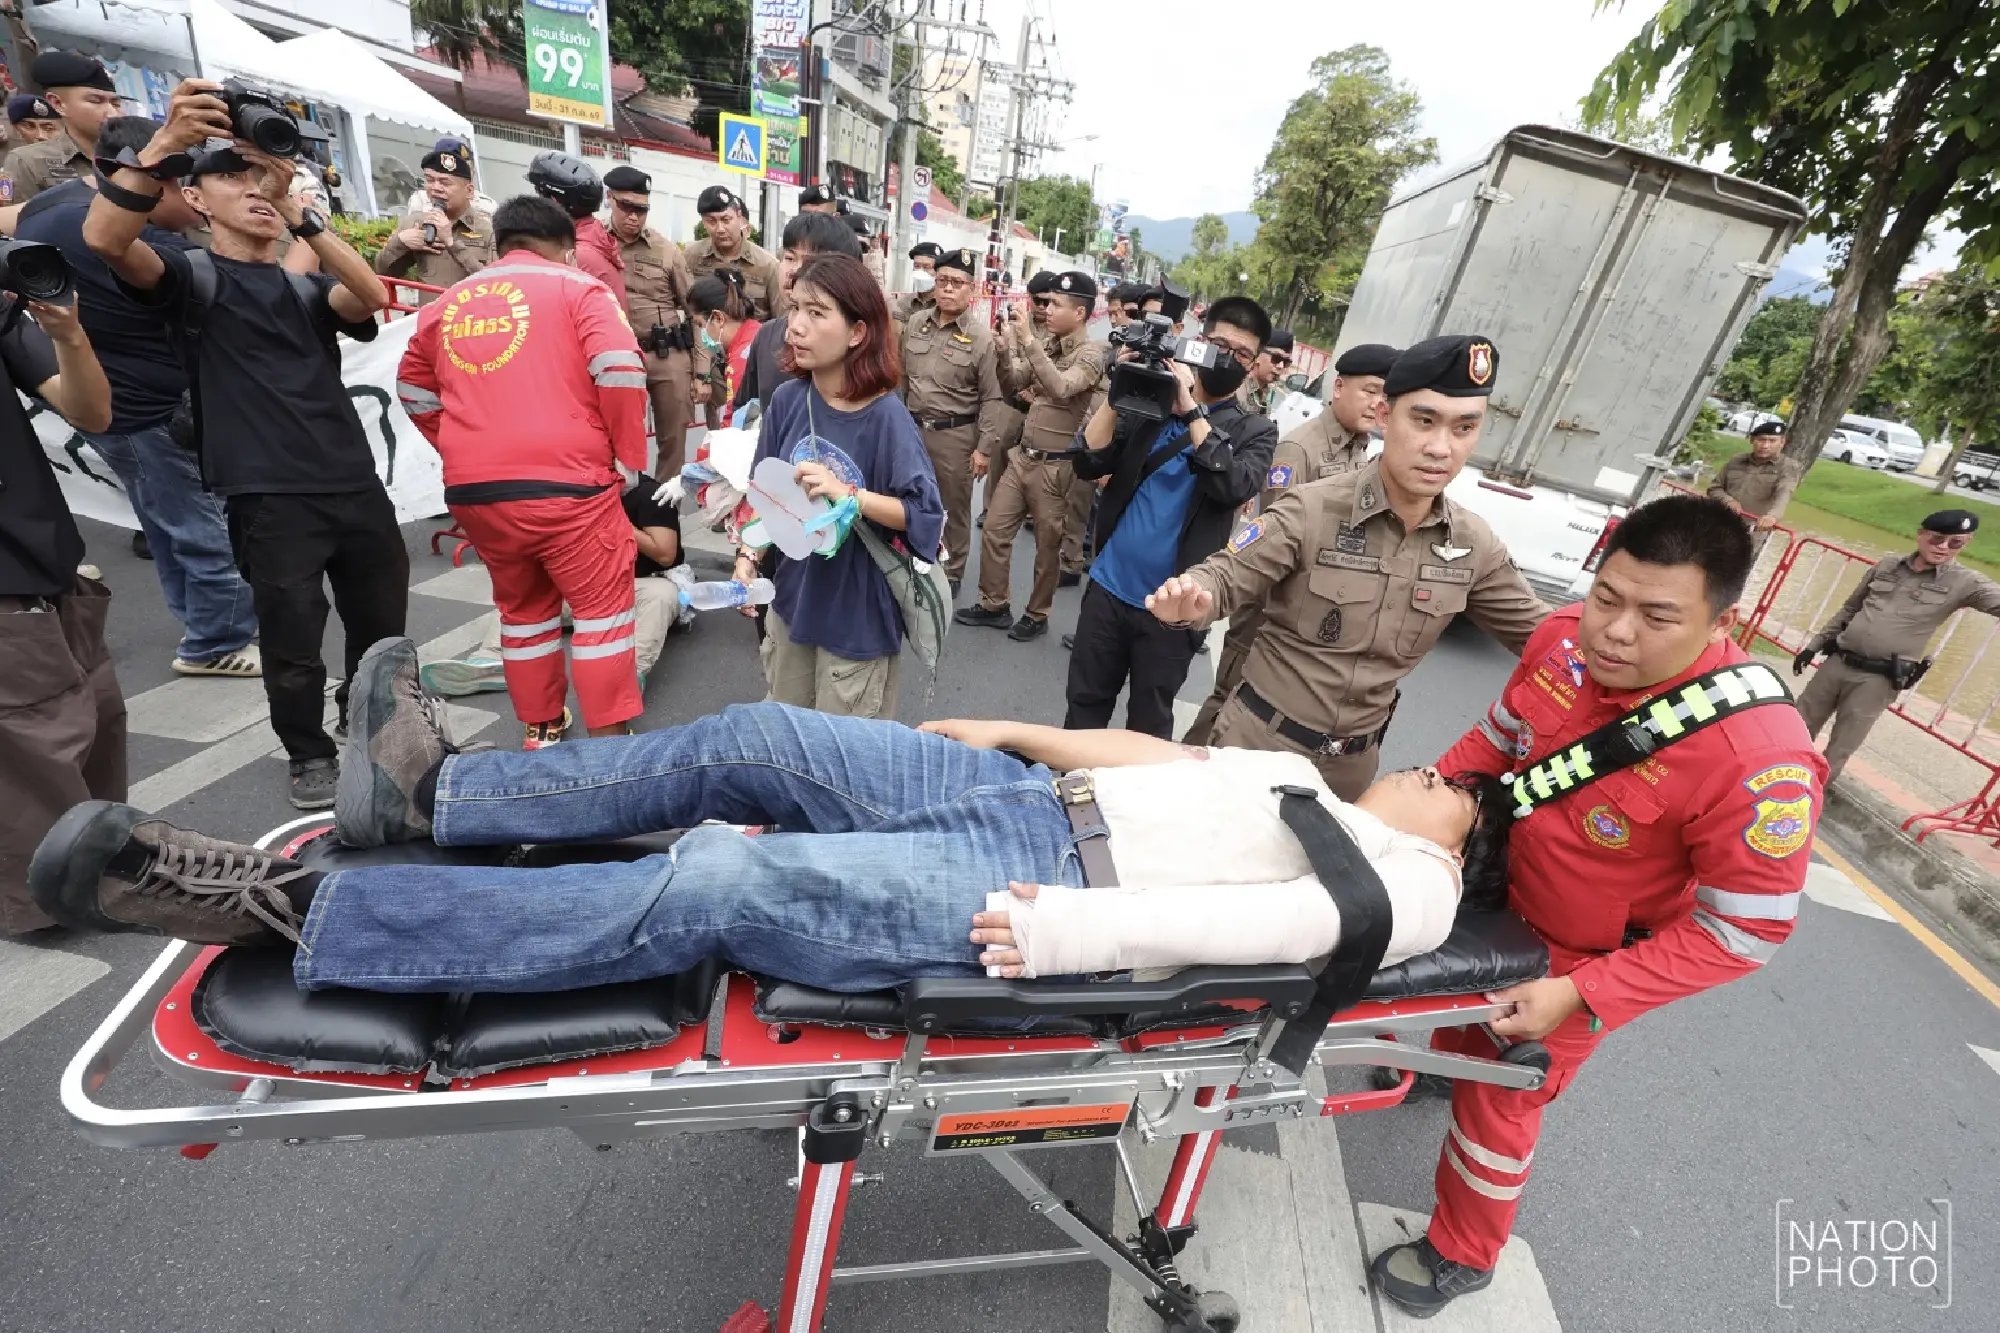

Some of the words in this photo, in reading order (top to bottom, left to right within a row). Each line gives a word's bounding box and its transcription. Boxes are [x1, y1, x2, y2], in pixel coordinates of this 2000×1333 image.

[766, 17, 797, 33] BIG
[532, 25, 591, 48] ผ่อนเริ่มต้น
[754, 32, 802, 48] SALE
[534, 43, 584, 88] 99
[581, 80, 600, 92] บาท
[534, 99, 554, 112] วันนี้
[452, 314, 513, 338] ยโสธร
[481, 319, 530, 375] FOUNDATION
[1753, 768, 1808, 788] RESCUE
